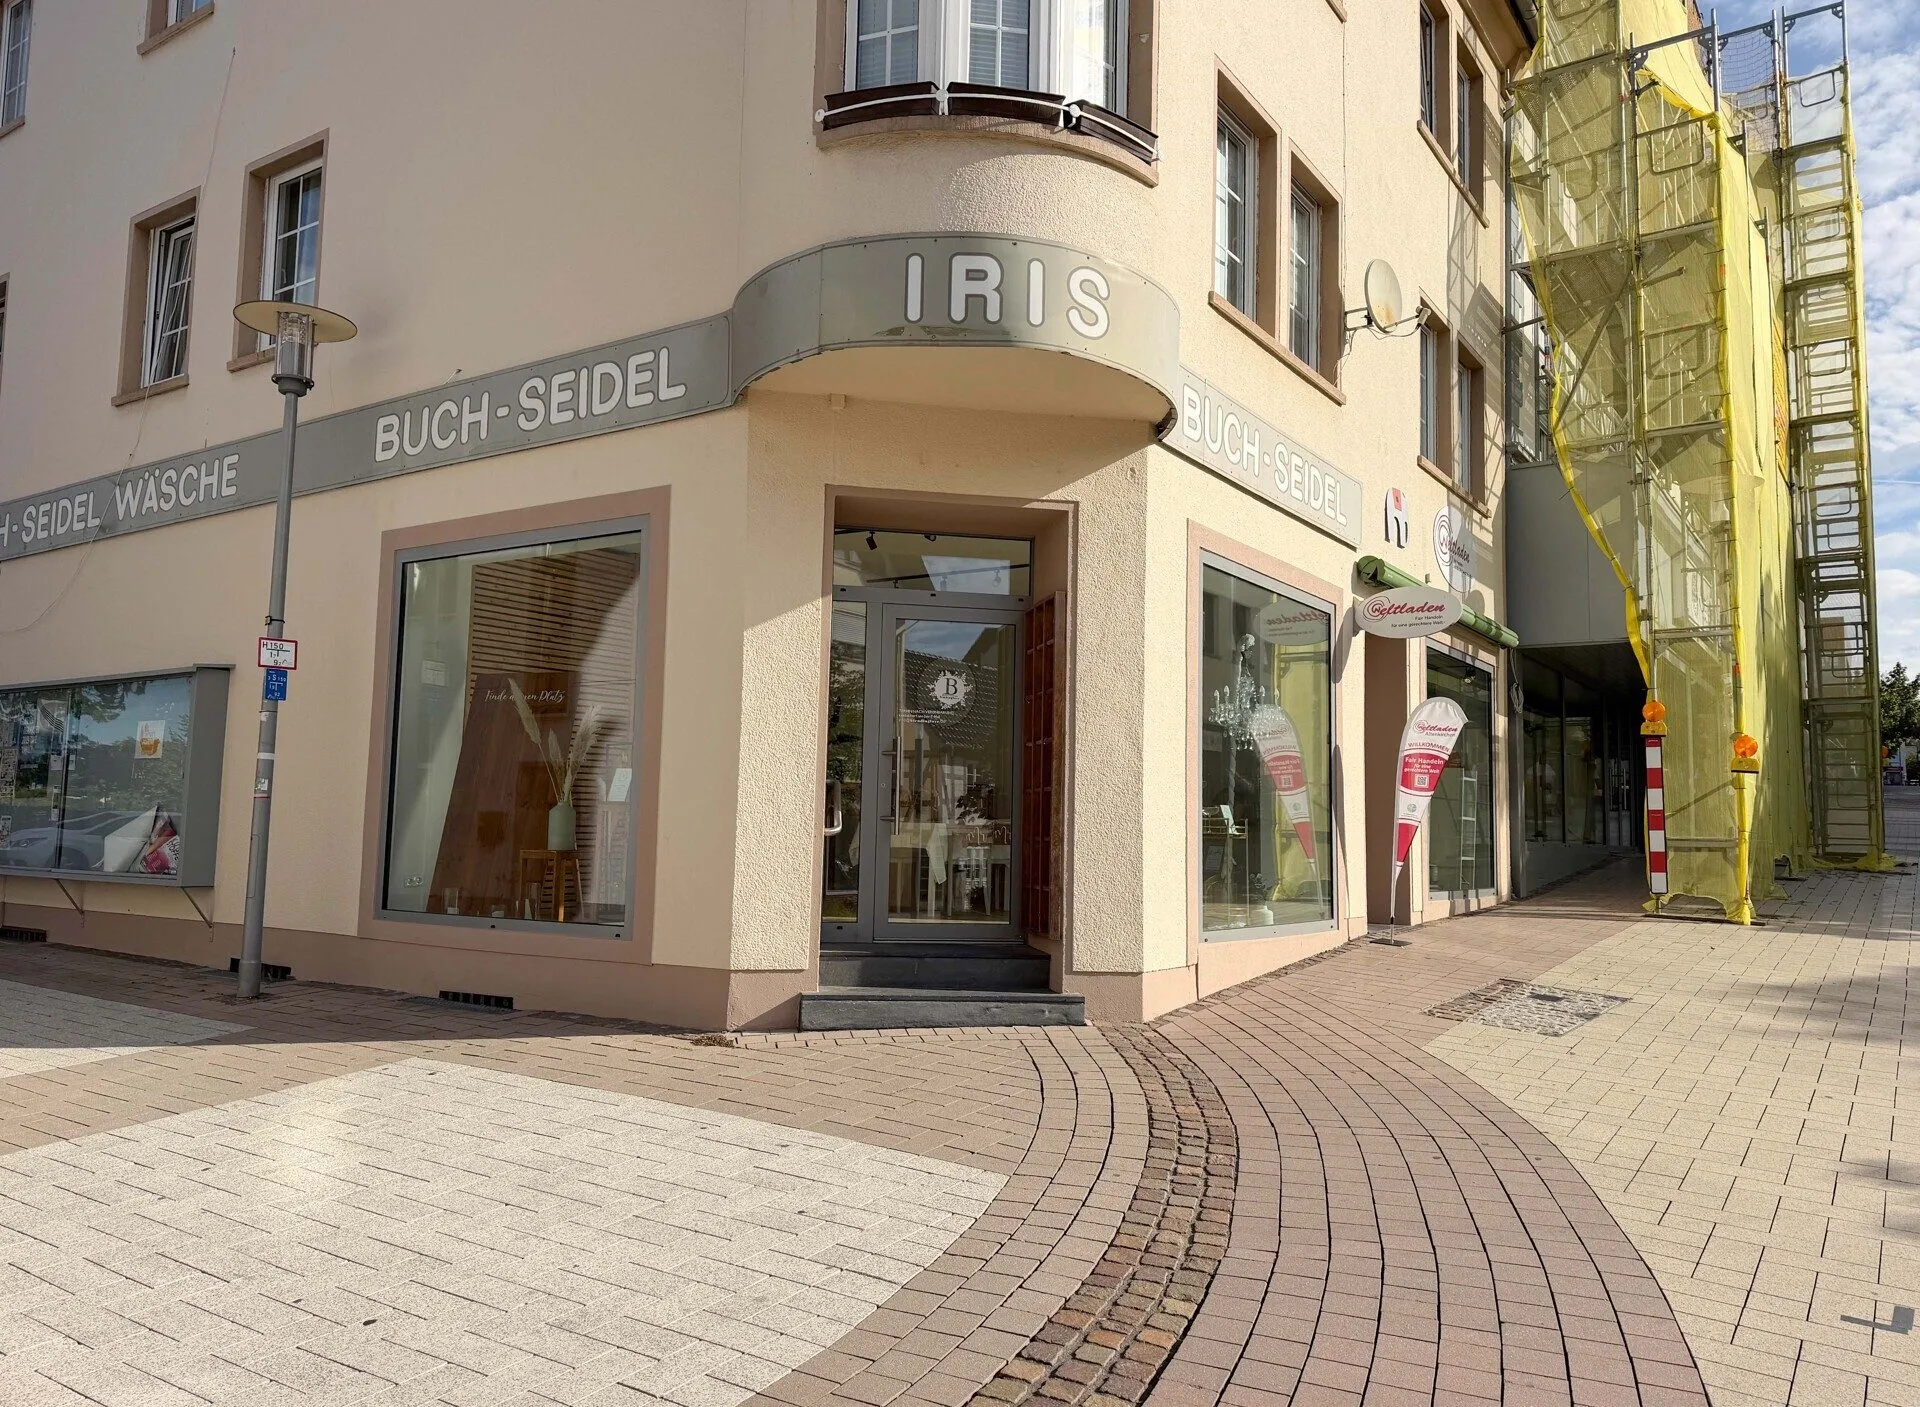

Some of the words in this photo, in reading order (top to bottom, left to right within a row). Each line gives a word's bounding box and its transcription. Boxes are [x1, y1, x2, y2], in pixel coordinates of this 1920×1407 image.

[907, 253, 1109, 338] IRIS
[114, 453, 240, 521] WÄSCHE
[1367, 601, 1446, 618] Weltladen
[943, 677, 958, 696] B
[1407, 742, 1450, 753] WILLKOMMEN
[1418, 757, 1444, 765] Handeln
